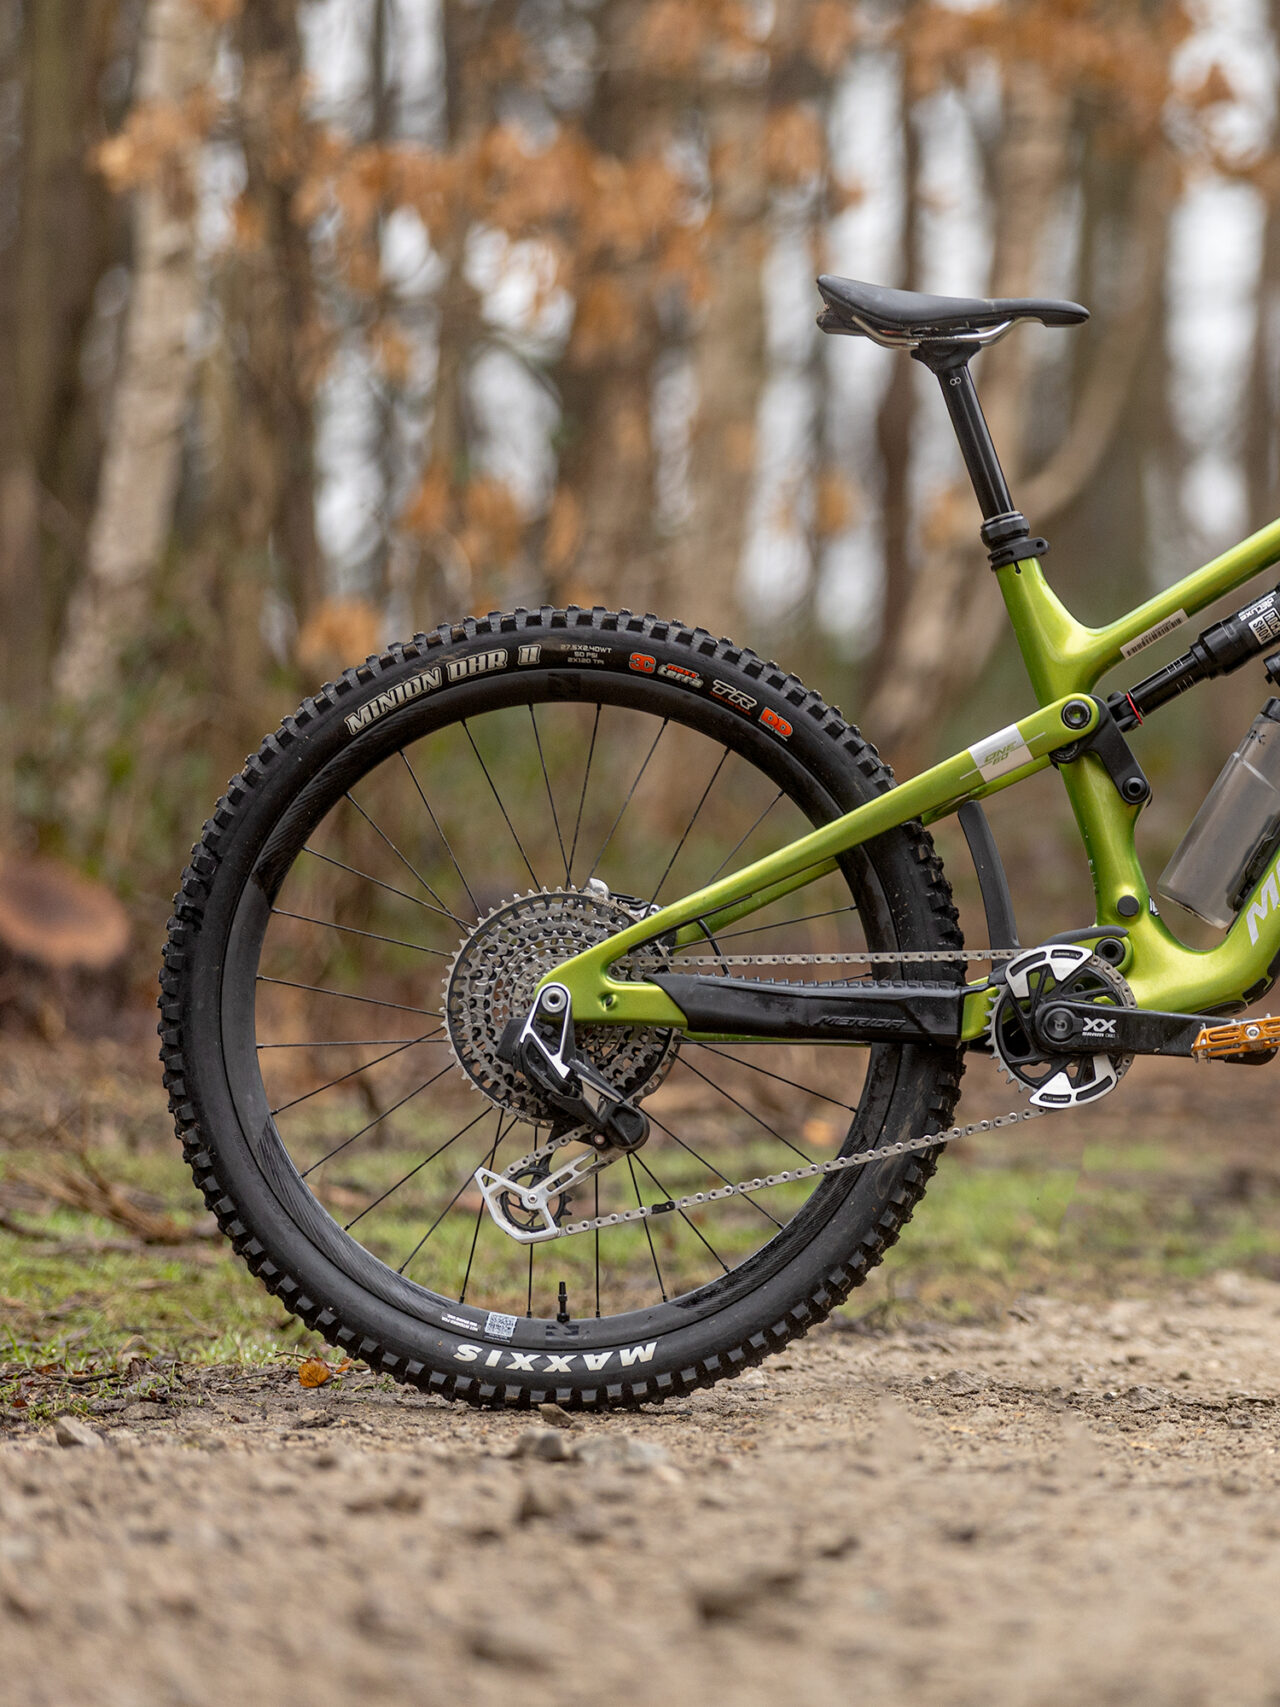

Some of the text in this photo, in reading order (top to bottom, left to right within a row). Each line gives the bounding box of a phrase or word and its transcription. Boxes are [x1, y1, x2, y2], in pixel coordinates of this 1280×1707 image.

[1253, 620, 1272, 641] SHOX
[629, 652, 656, 674] 3C
[657, 665, 704, 688] terra
[344, 644, 541, 736] MINION DHR II
[712, 679, 757, 710] TR
[760, 706, 793, 737] DD
[1083, 1017, 1117, 1033] XX
[453, 1341, 658, 1373] MAXXIS
